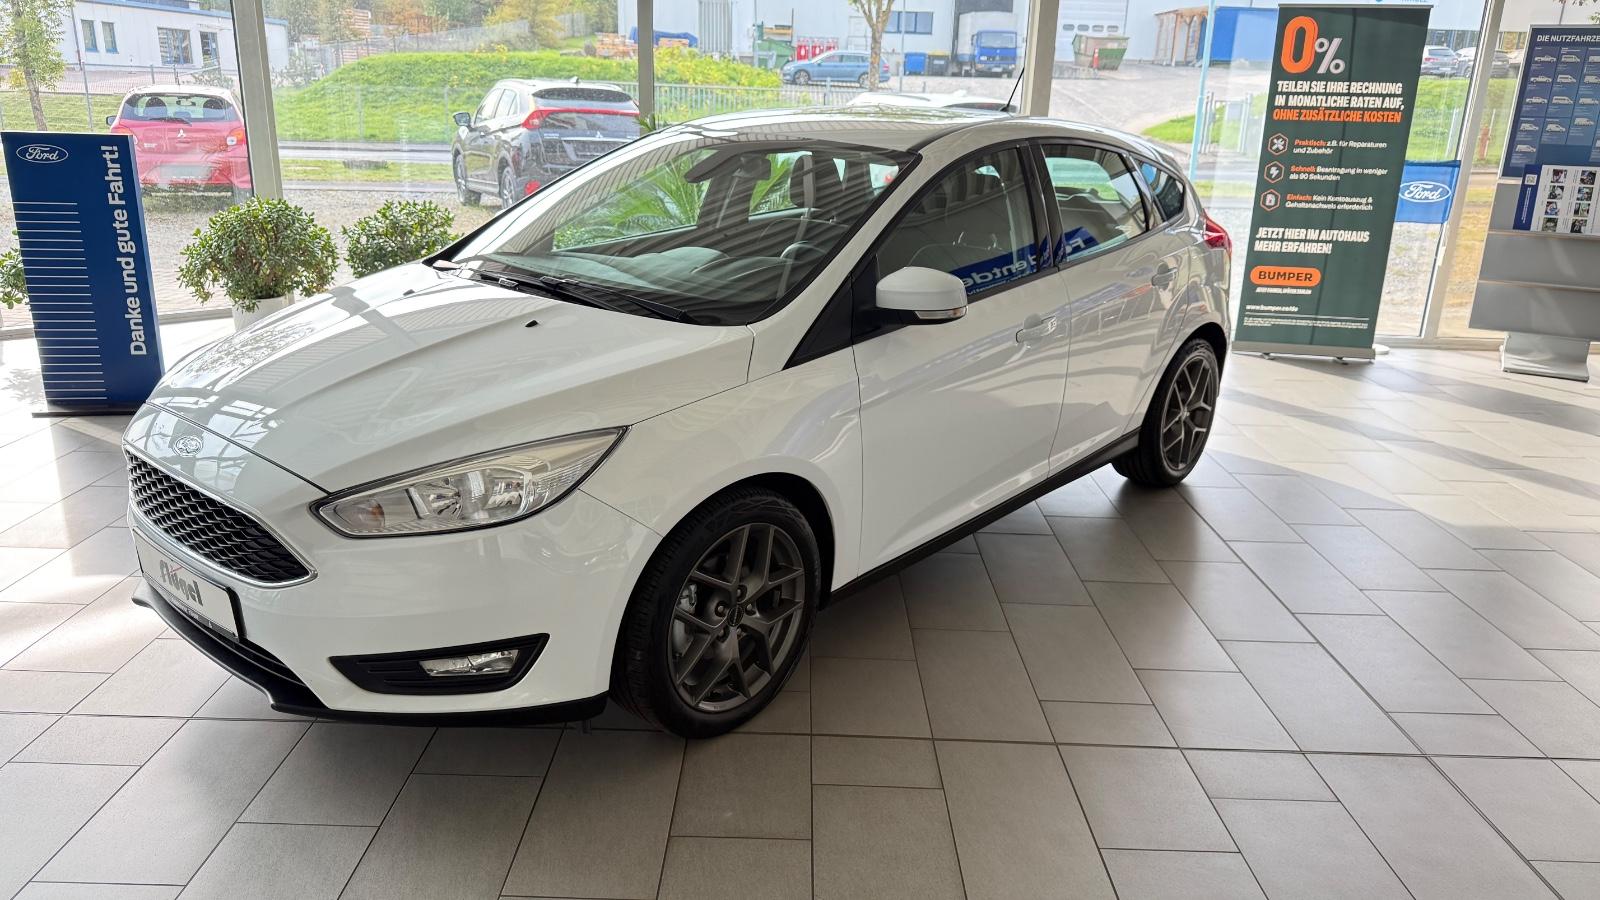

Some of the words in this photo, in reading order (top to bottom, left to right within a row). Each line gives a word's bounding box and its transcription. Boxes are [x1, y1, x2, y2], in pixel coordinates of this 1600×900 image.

[1281, 16, 1345, 74] 0%
[1277, 81, 1311, 92] TEILEN
[1311, 81, 1326, 93] SIE
[1327, 82, 1349, 93] IHRE
[1350, 82, 1402, 95] RECHNUNG
[1275, 95, 1286, 106] IN
[1289, 95, 1350, 108] MONATLICHE
[1350, 96, 1384, 108] RATEN
[1384, 98, 1405, 110] AUF,
[1273, 109, 1299, 121] OHNE
[1300, 107, 1364, 122] ZUSÄTZLICHE
[1363, 111, 1402, 123] KOSTEN
[1348, 140, 1387, 148] Reparaturen
[26, 146, 60, 161] Ford
[100, 145, 125, 206] Fahrt!
[1316, 166, 1356, 175] Beantragung
[1363, 167, 1388, 175] weniger
[1403, 183, 1442, 200] Ford
[112, 209, 136, 253] gute
[1256, 227, 1283, 239] JETZT
[1284, 227, 1307, 239] HIER
[1307, 229, 1319, 240] IM
[1319, 229, 1370, 242] AUTOHAUS
[1254, 241, 1281, 252] MEHR
[1281, 242, 1333, 254] ERFAHREN!
[116, 257, 138, 293] und
[1258, 270, 1313, 282] BUMPER
[125, 297, 147, 356] Danke
